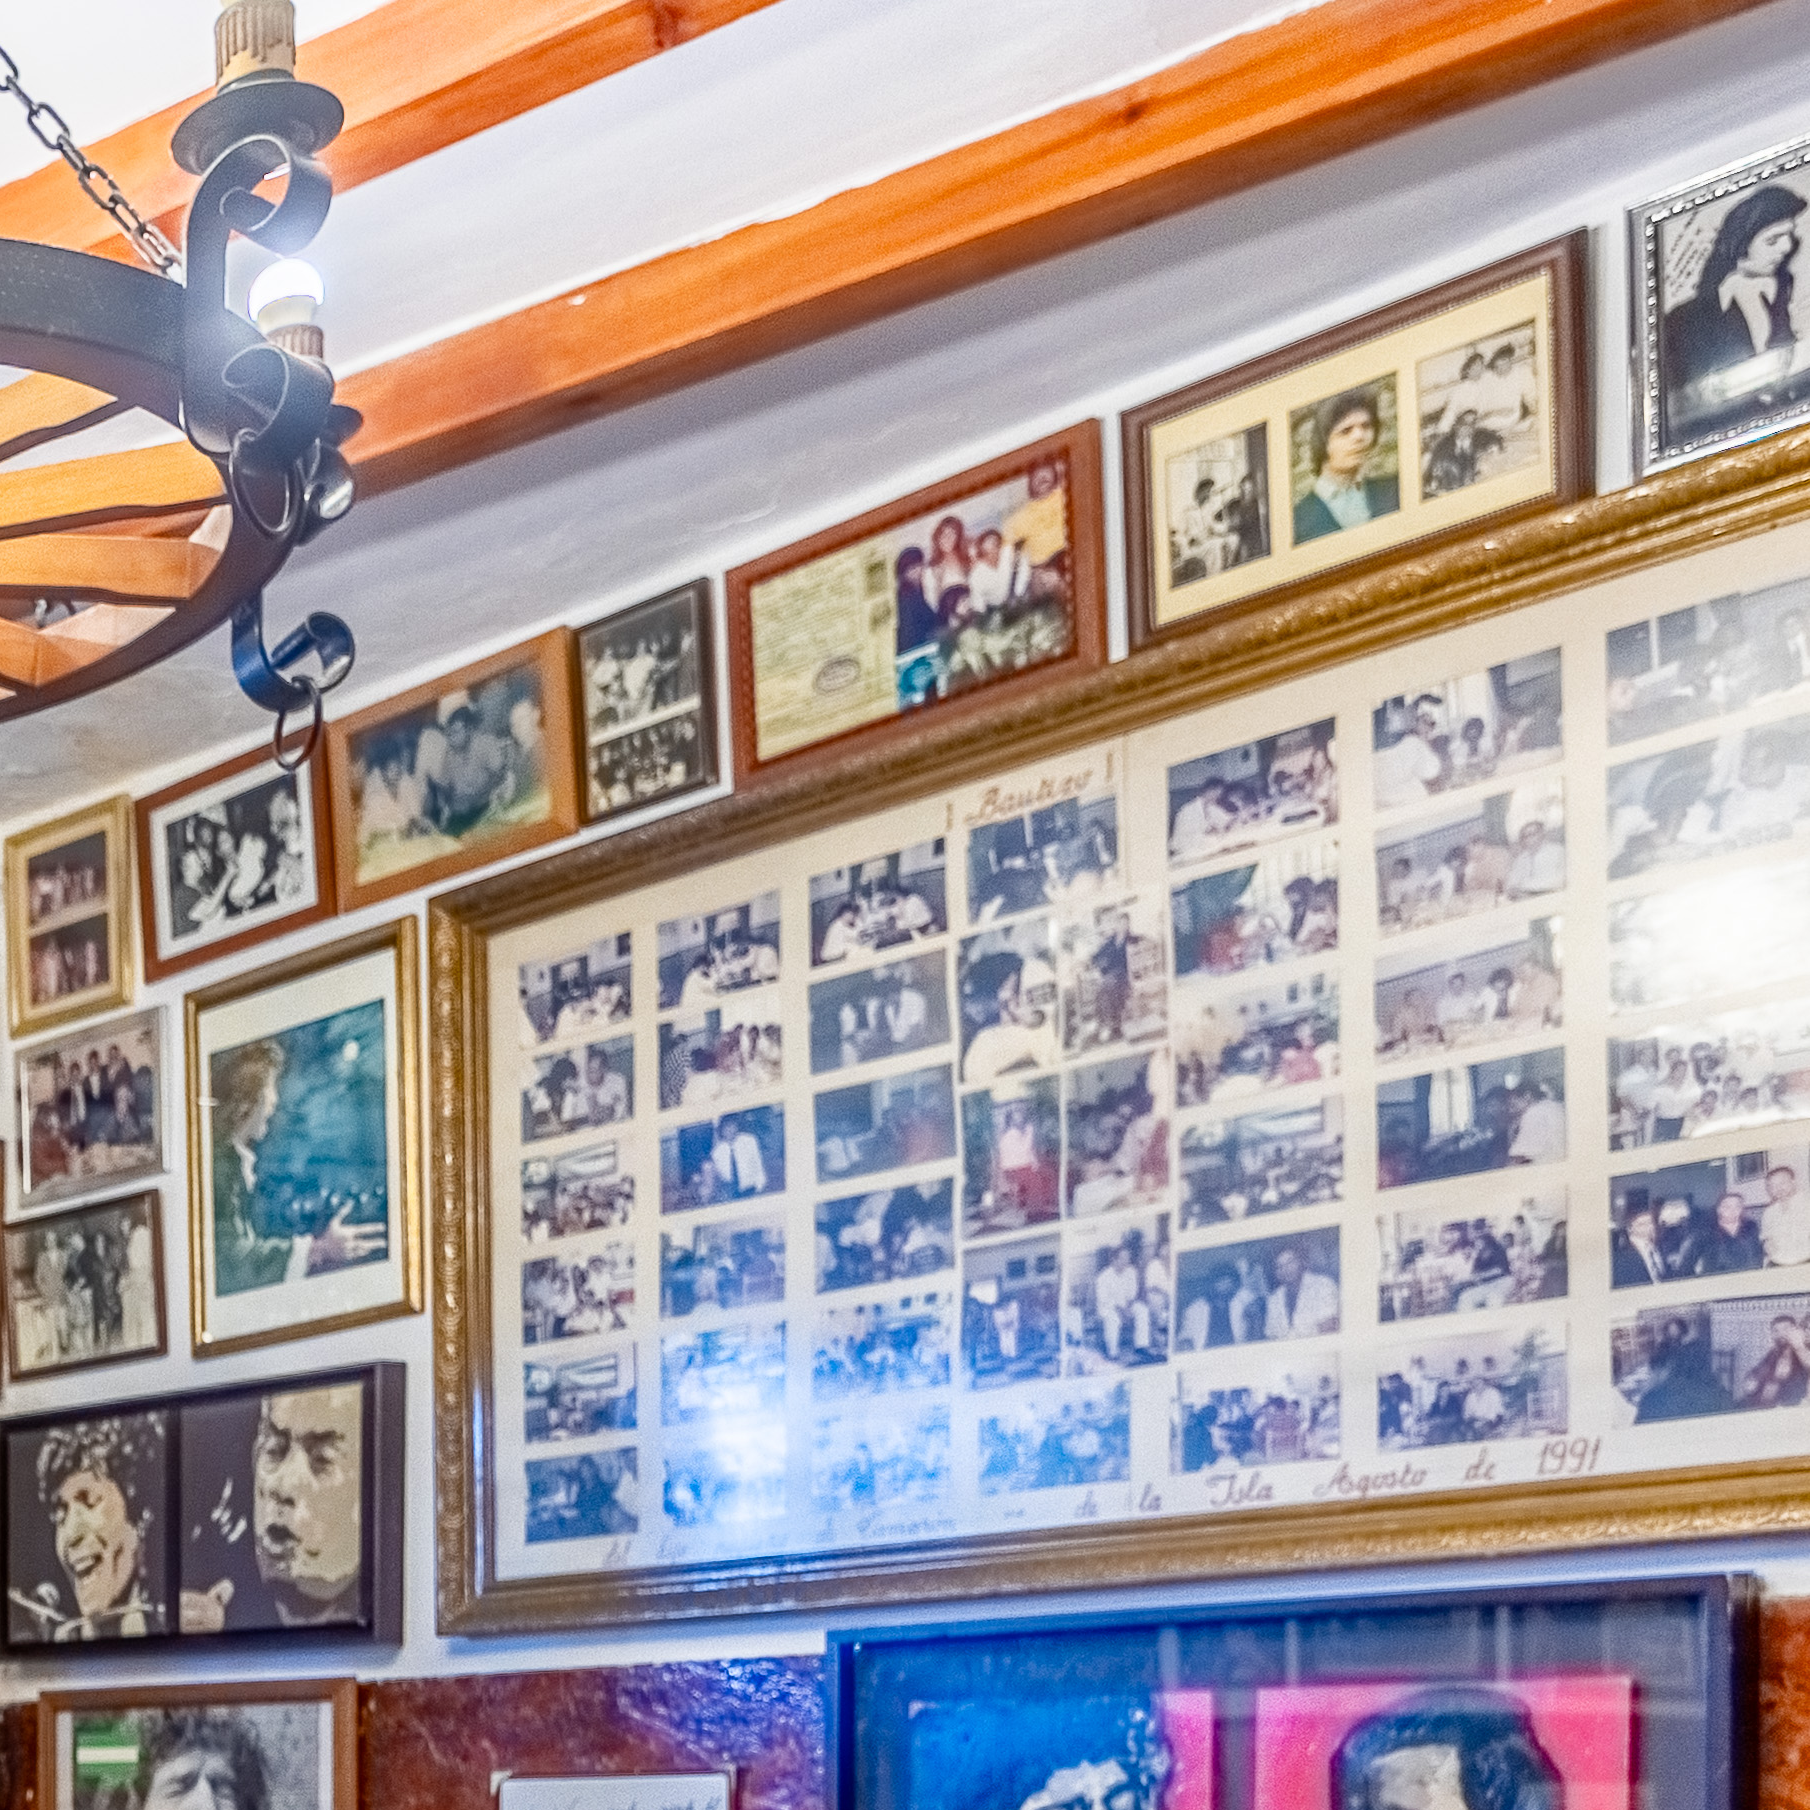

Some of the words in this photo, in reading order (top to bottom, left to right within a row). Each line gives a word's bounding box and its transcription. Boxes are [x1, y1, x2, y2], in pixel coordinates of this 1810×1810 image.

[1137, 1482, 1163, 1512] la
[1205, 1466, 1275, 1509] Isla
[1312, 1461, 1429, 1500] Agosto
[1464, 1446, 1497, 1483] de
[1537, 1436, 1602, 1476] 1991
